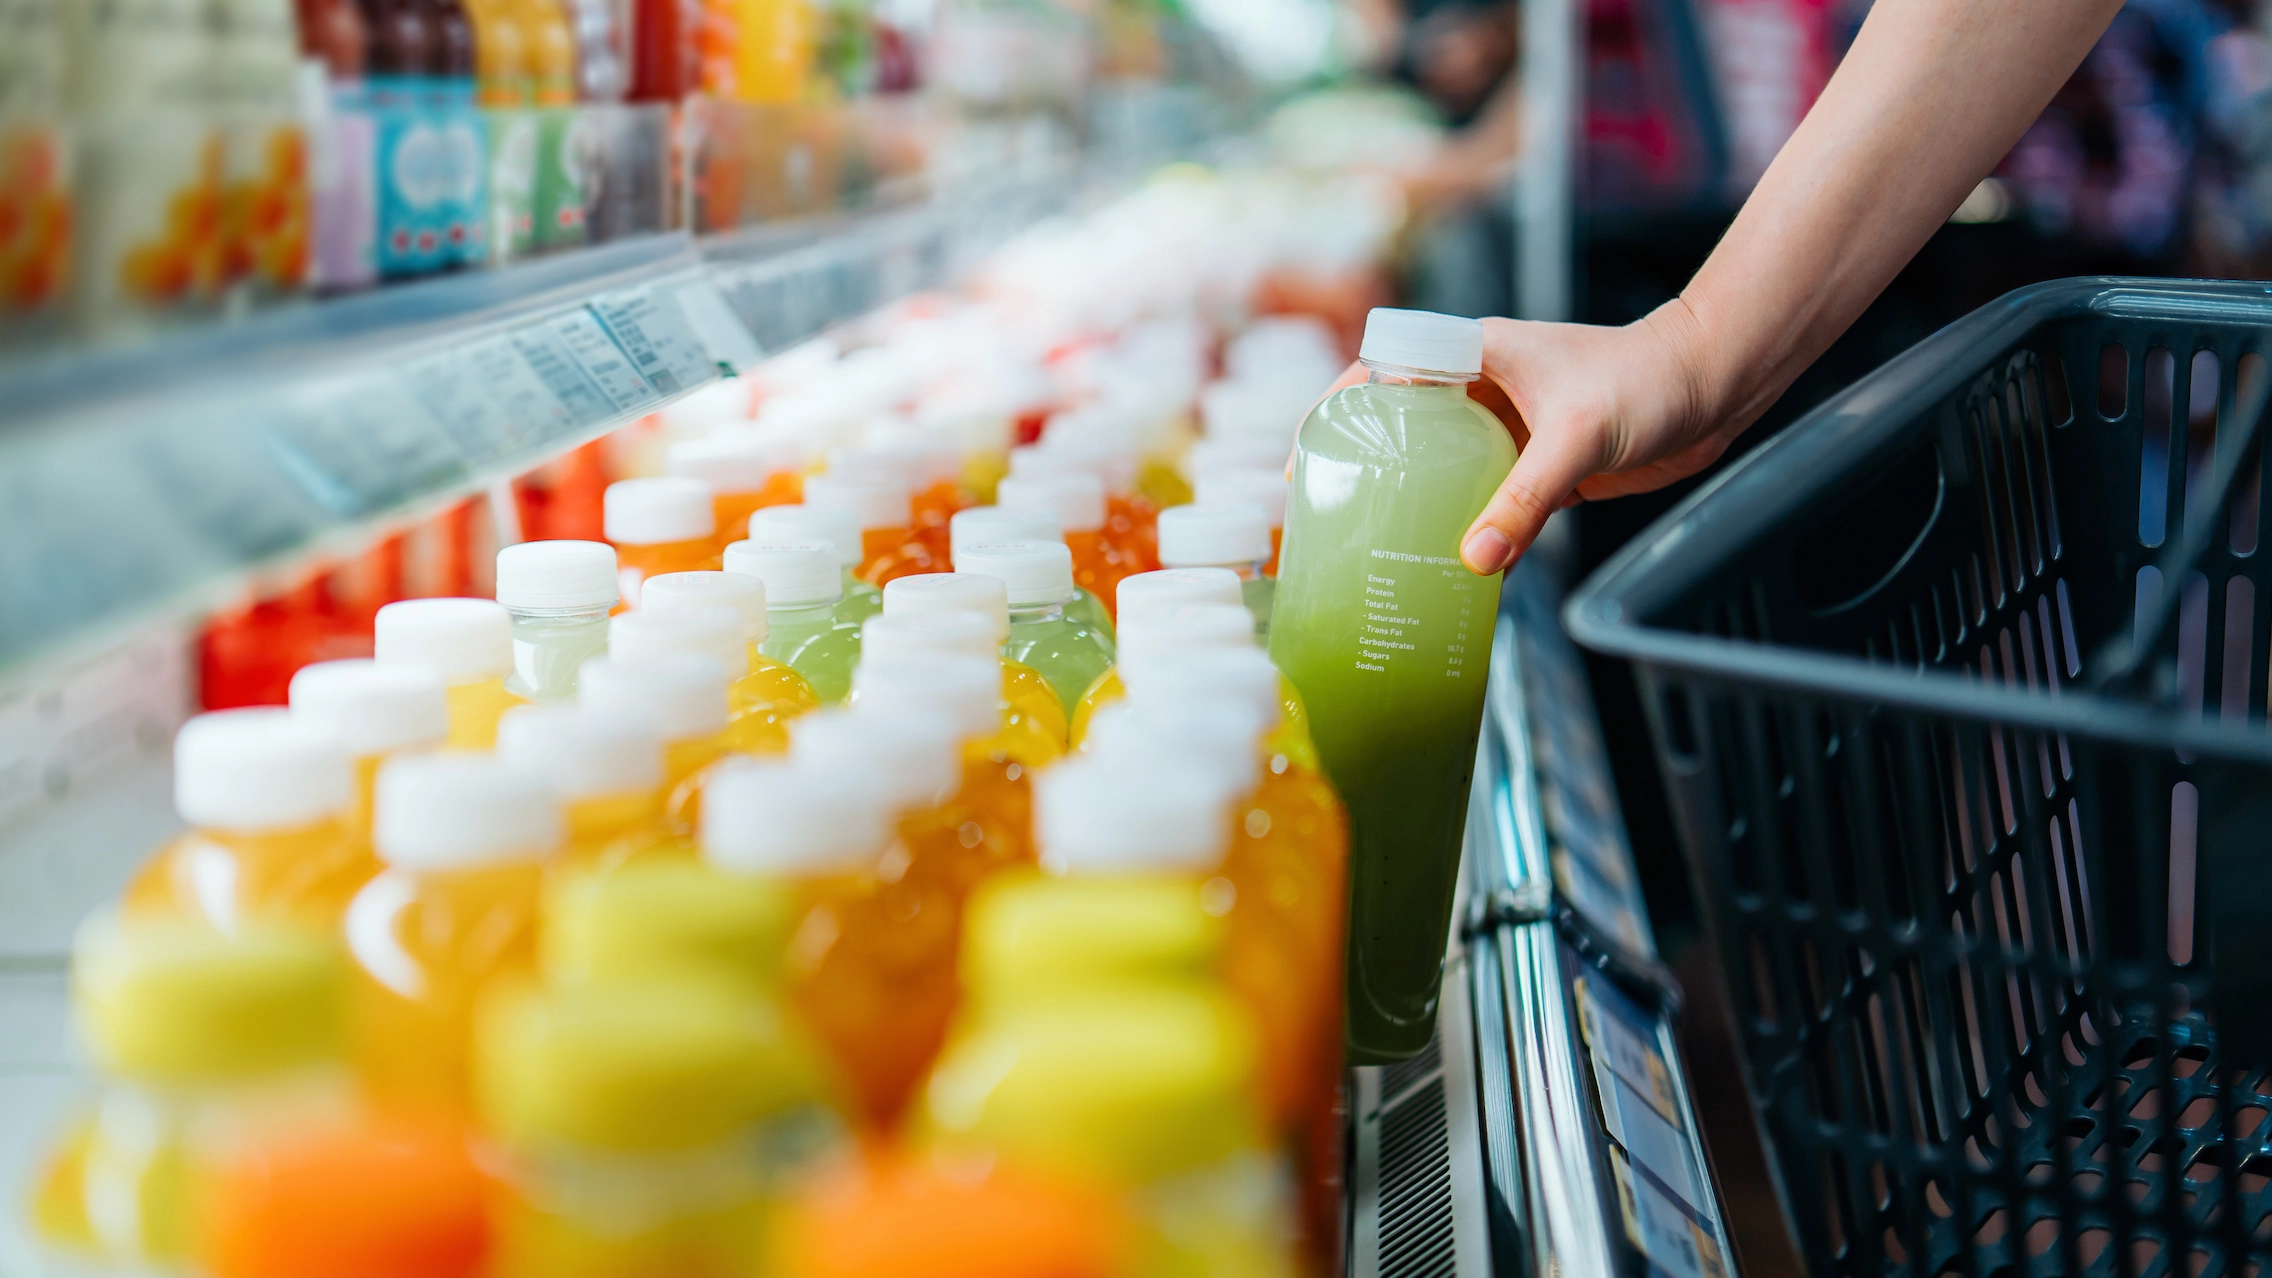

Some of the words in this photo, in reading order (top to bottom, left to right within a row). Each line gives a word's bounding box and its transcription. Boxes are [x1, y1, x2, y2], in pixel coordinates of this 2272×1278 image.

[1372, 549, 1421, 562] NUTRITION
[1423, 556, 1461, 566] INFORMA
[1368, 574, 1396, 586] Energy
[1366, 586, 1394, 598] Protein
[1364, 600, 1384, 608] Total
[1386, 602, 1398, 610] Fat
[1368, 612, 1406, 624] Saturated
[1407, 618, 1420, 626] Fat
[1366, 624, 1388, 634] Trans
[1390, 628, 1402, 636] Fat
[1359, 636, 1414, 650] Carbohydrates
[1362, 650, 1390, 660] Sugars
[1356, 661, 1384, 672] Sodium
